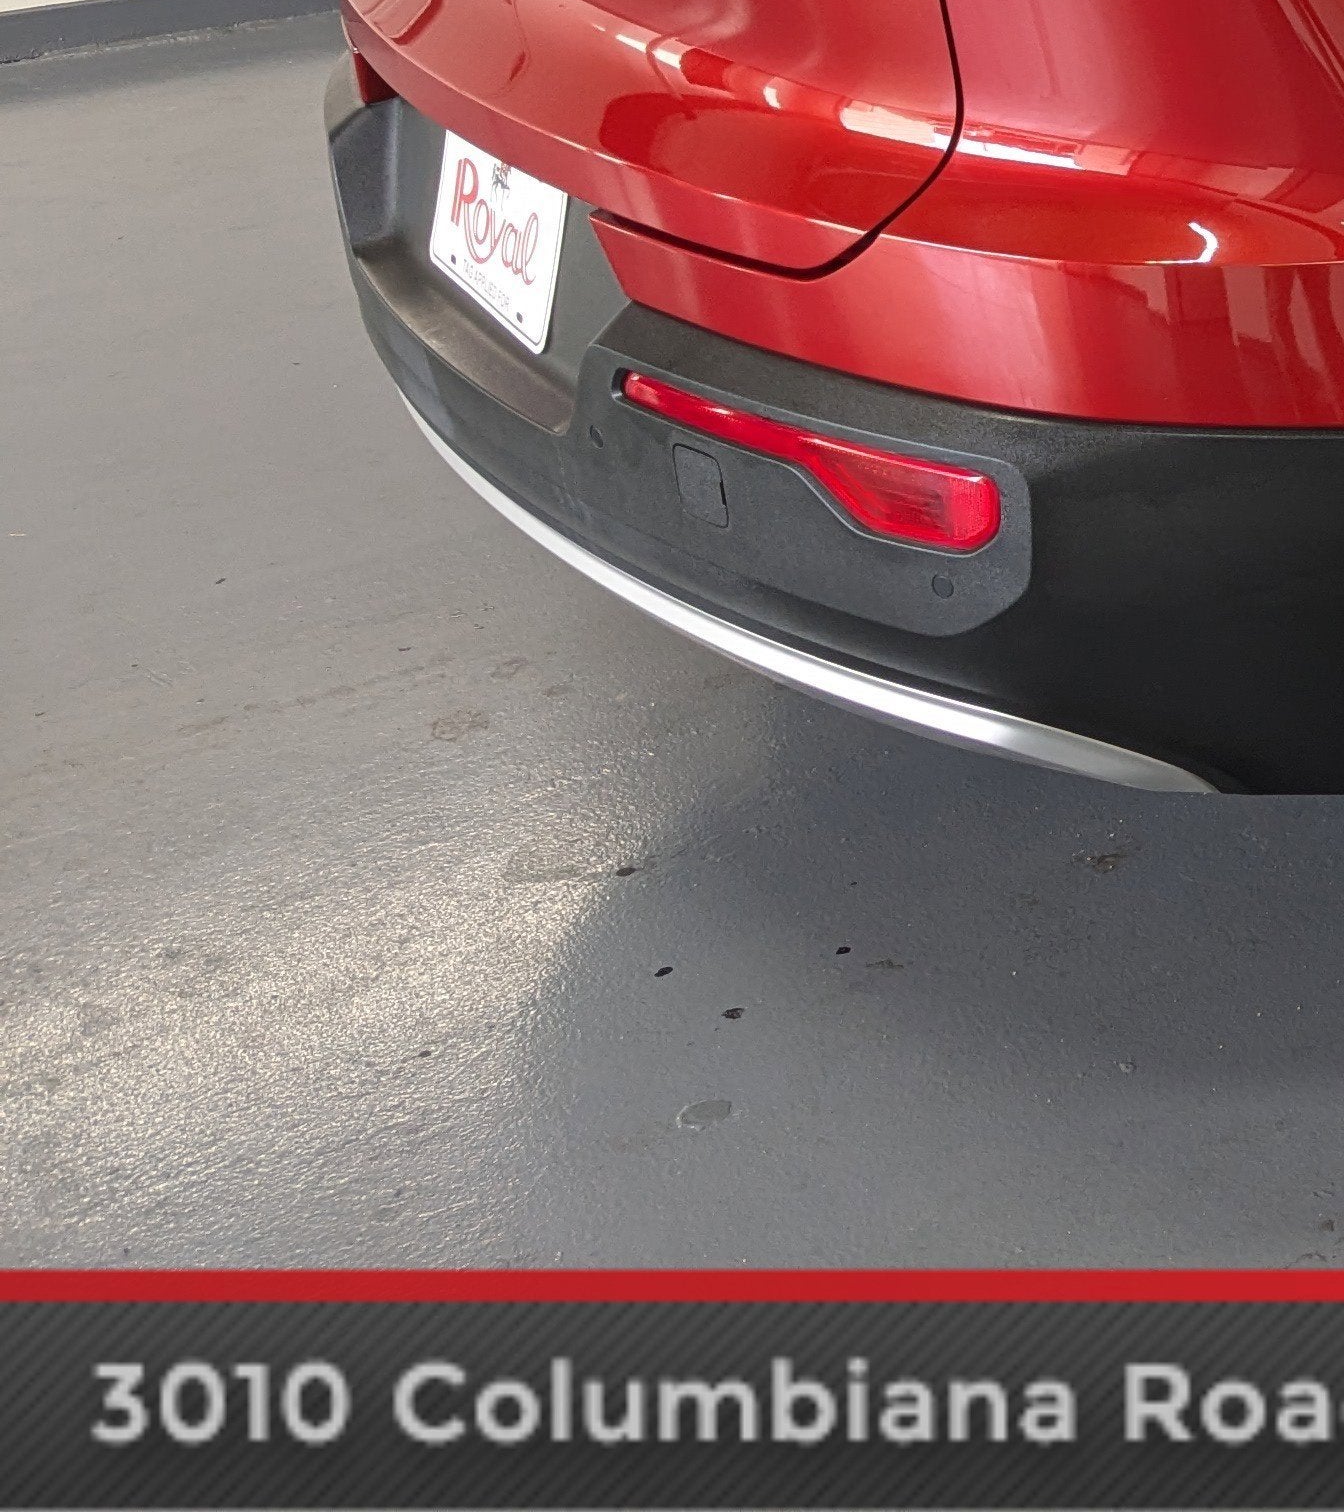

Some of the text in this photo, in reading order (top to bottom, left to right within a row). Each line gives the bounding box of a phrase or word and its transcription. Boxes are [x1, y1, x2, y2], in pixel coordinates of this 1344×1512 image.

[450, 157, 539, 286] Royal
[463, 259, 511, 311] TAG APPLIED FOR
